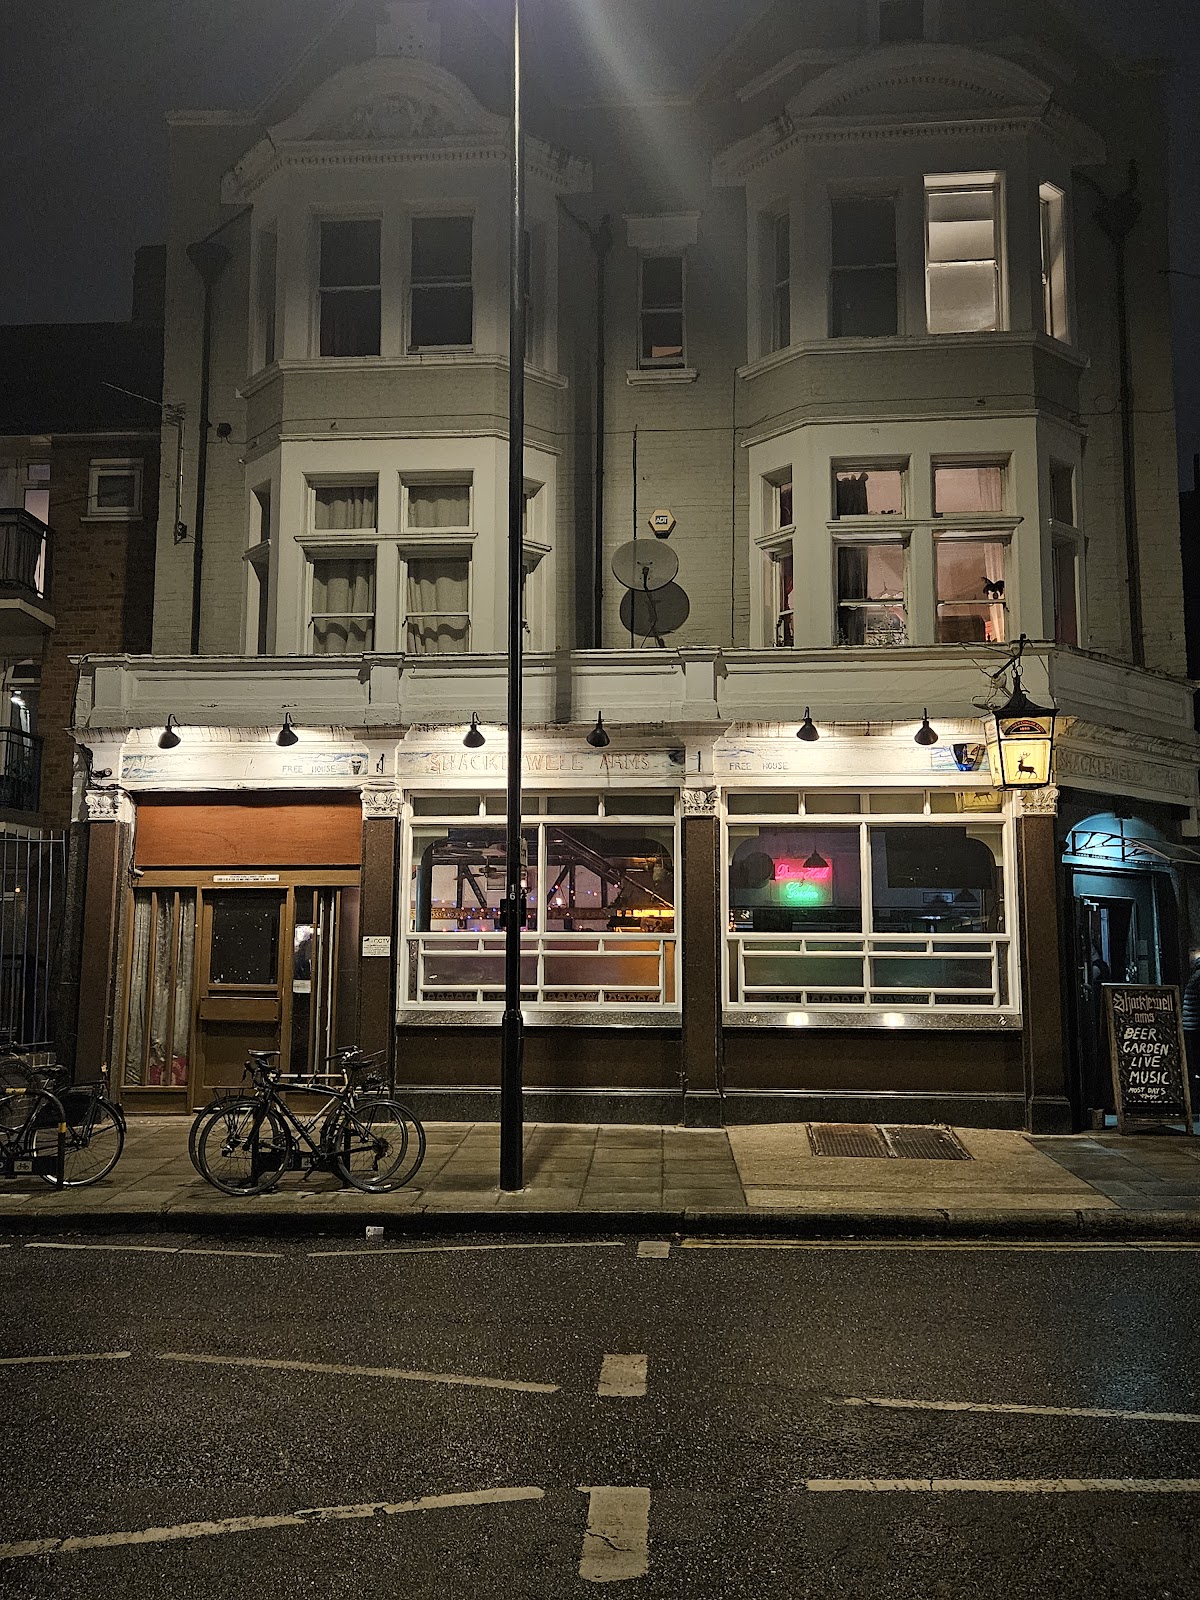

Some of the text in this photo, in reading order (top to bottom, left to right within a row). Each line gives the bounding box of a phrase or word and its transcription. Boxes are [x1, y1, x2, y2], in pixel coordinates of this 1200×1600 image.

[655, 516, 668, 524] ADT
[599, 752, 650, 770] ARMS
[729, 761, 789, 771] FREE HOUSE
[282, 764, 337, 773] FREE HOUSE
[1123, 1027, 1157, 1041] BEER
[1122, 1041, 1169, 1056] GARDEN
[1130, 1056, 1161, 1068] LIVE
[1129, 1070, 1169, 1085] MUSIC
[1147, 1087, 1166, 1095] DAYS
